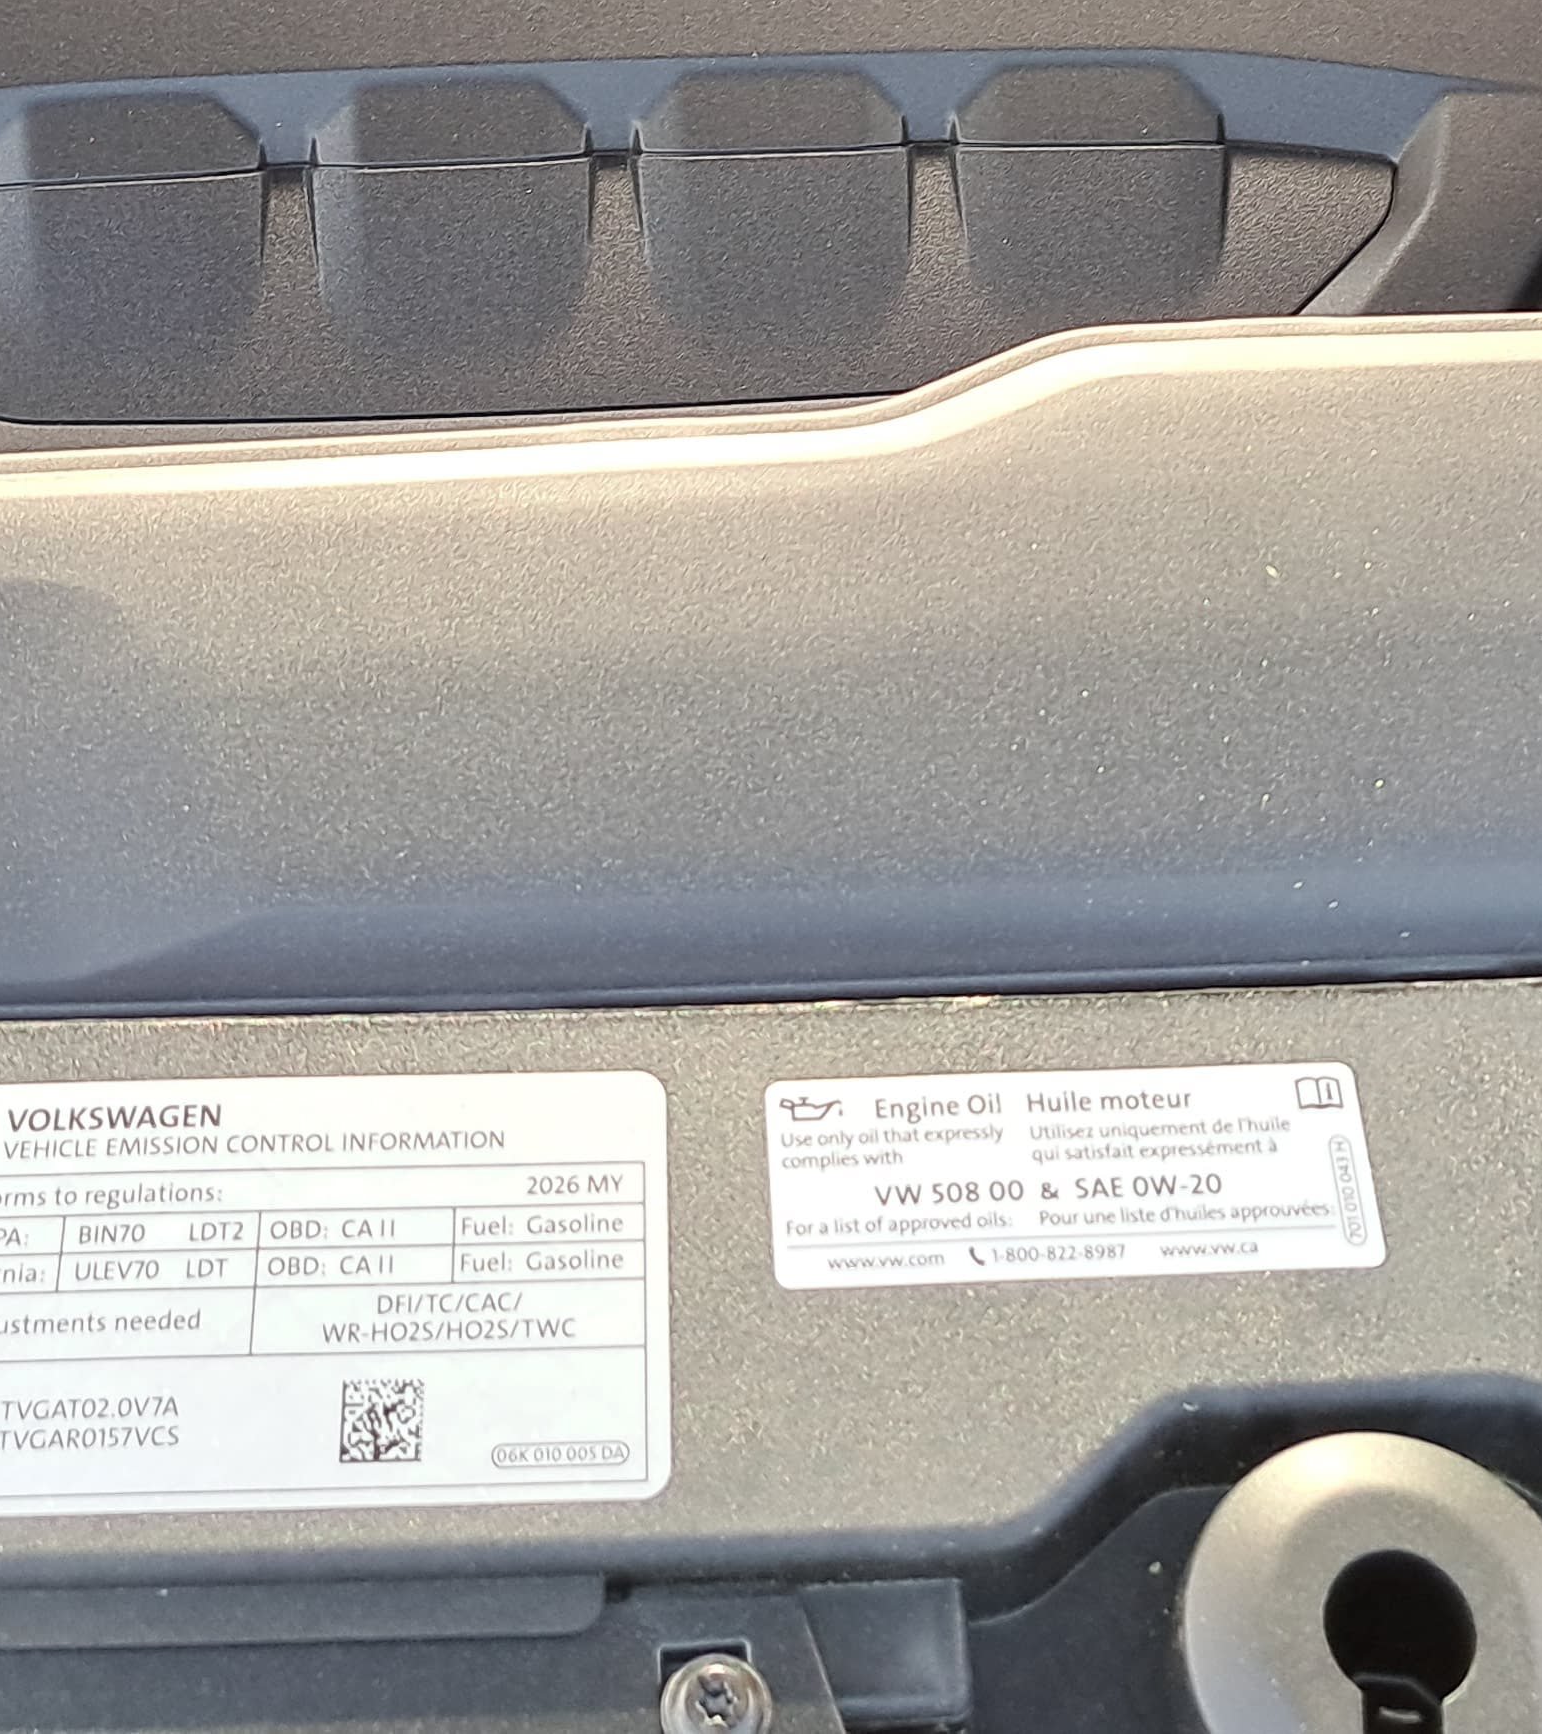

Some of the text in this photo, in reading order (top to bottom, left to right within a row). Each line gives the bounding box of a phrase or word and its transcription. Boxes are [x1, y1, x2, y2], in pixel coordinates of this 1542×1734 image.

[8, 1104, 222, 1133] VOLKSWAGEN
[875, 1091, 1191, 1124] Engine Oil Huile moteur
[780, 1124, 1004, 1150] Use only oil that expressly
[1029, 1123, 1094, 1141] Utilisez
[1098, 1120, 1207, 1142] uniquement
[1212, 1119, 1234, 1134] de
[4, 1131, 506, 1160] VEHICLE EMISSION CONTROL INFORMATION
[1031, 1147, 1059, 1166] qui
[1064, 1142, 1134, 1162] satisfait
[1268, 1136, 1278, 1153] à
[781, 1149, 904, 1172] complies with
[55, 1187, 78, 1206] to
[85, 1183, 223, 1209] regulations:
[526, 1174, 624, 1195] 2026 MY
[874, 1173, 1222, 1206] VW 508 00 & SAE 0W-20
[78, 1224, 146, 1244] BIN70
[189, 1221, 244, 1242] LDT2
[269, 1219, 328, 1240] OBD:
[341, 1219, 372, 1238] CA
[461, 1215, 514, 1236] Fuel:
[526, 1212, 625, 1235] Gasoline
[786, 1219, 813, 1236] For
[819, 1222, 829, 1235] a
[834, 1217, 860, 1234] list
[865, 1215, 883, 1233] of
[888, 1214, 972, 1235] approved
[1039, 1204, 1226, 1227] Pour une liste d'huiles
[74, 1259, 160, 1281] ULEV70
[185, 1258, 229, 1278] LDT
[267, 1256, 326, 1276] OBD:
[339, 1255, 371, 1275] CA
[459, 1252, 513, 1273] Fuel:
[525, 1249, 625, 1272] Gasoline
[827, 1241, 1259, 1270] www.vw.com 1-800-822-8987 www.vw.ca
[376, 1291, 524, 1315] DFI/TC/CAC/
[114, 1308, 202, 1331] needed
[321, 1317, 578, 1344] WR-HO2S/HO2S/TWC
[0, 1395, 180, 1421] TVGAT02.0V7A
[496, 1444, 626, 1463] 06K 010 005 DA
